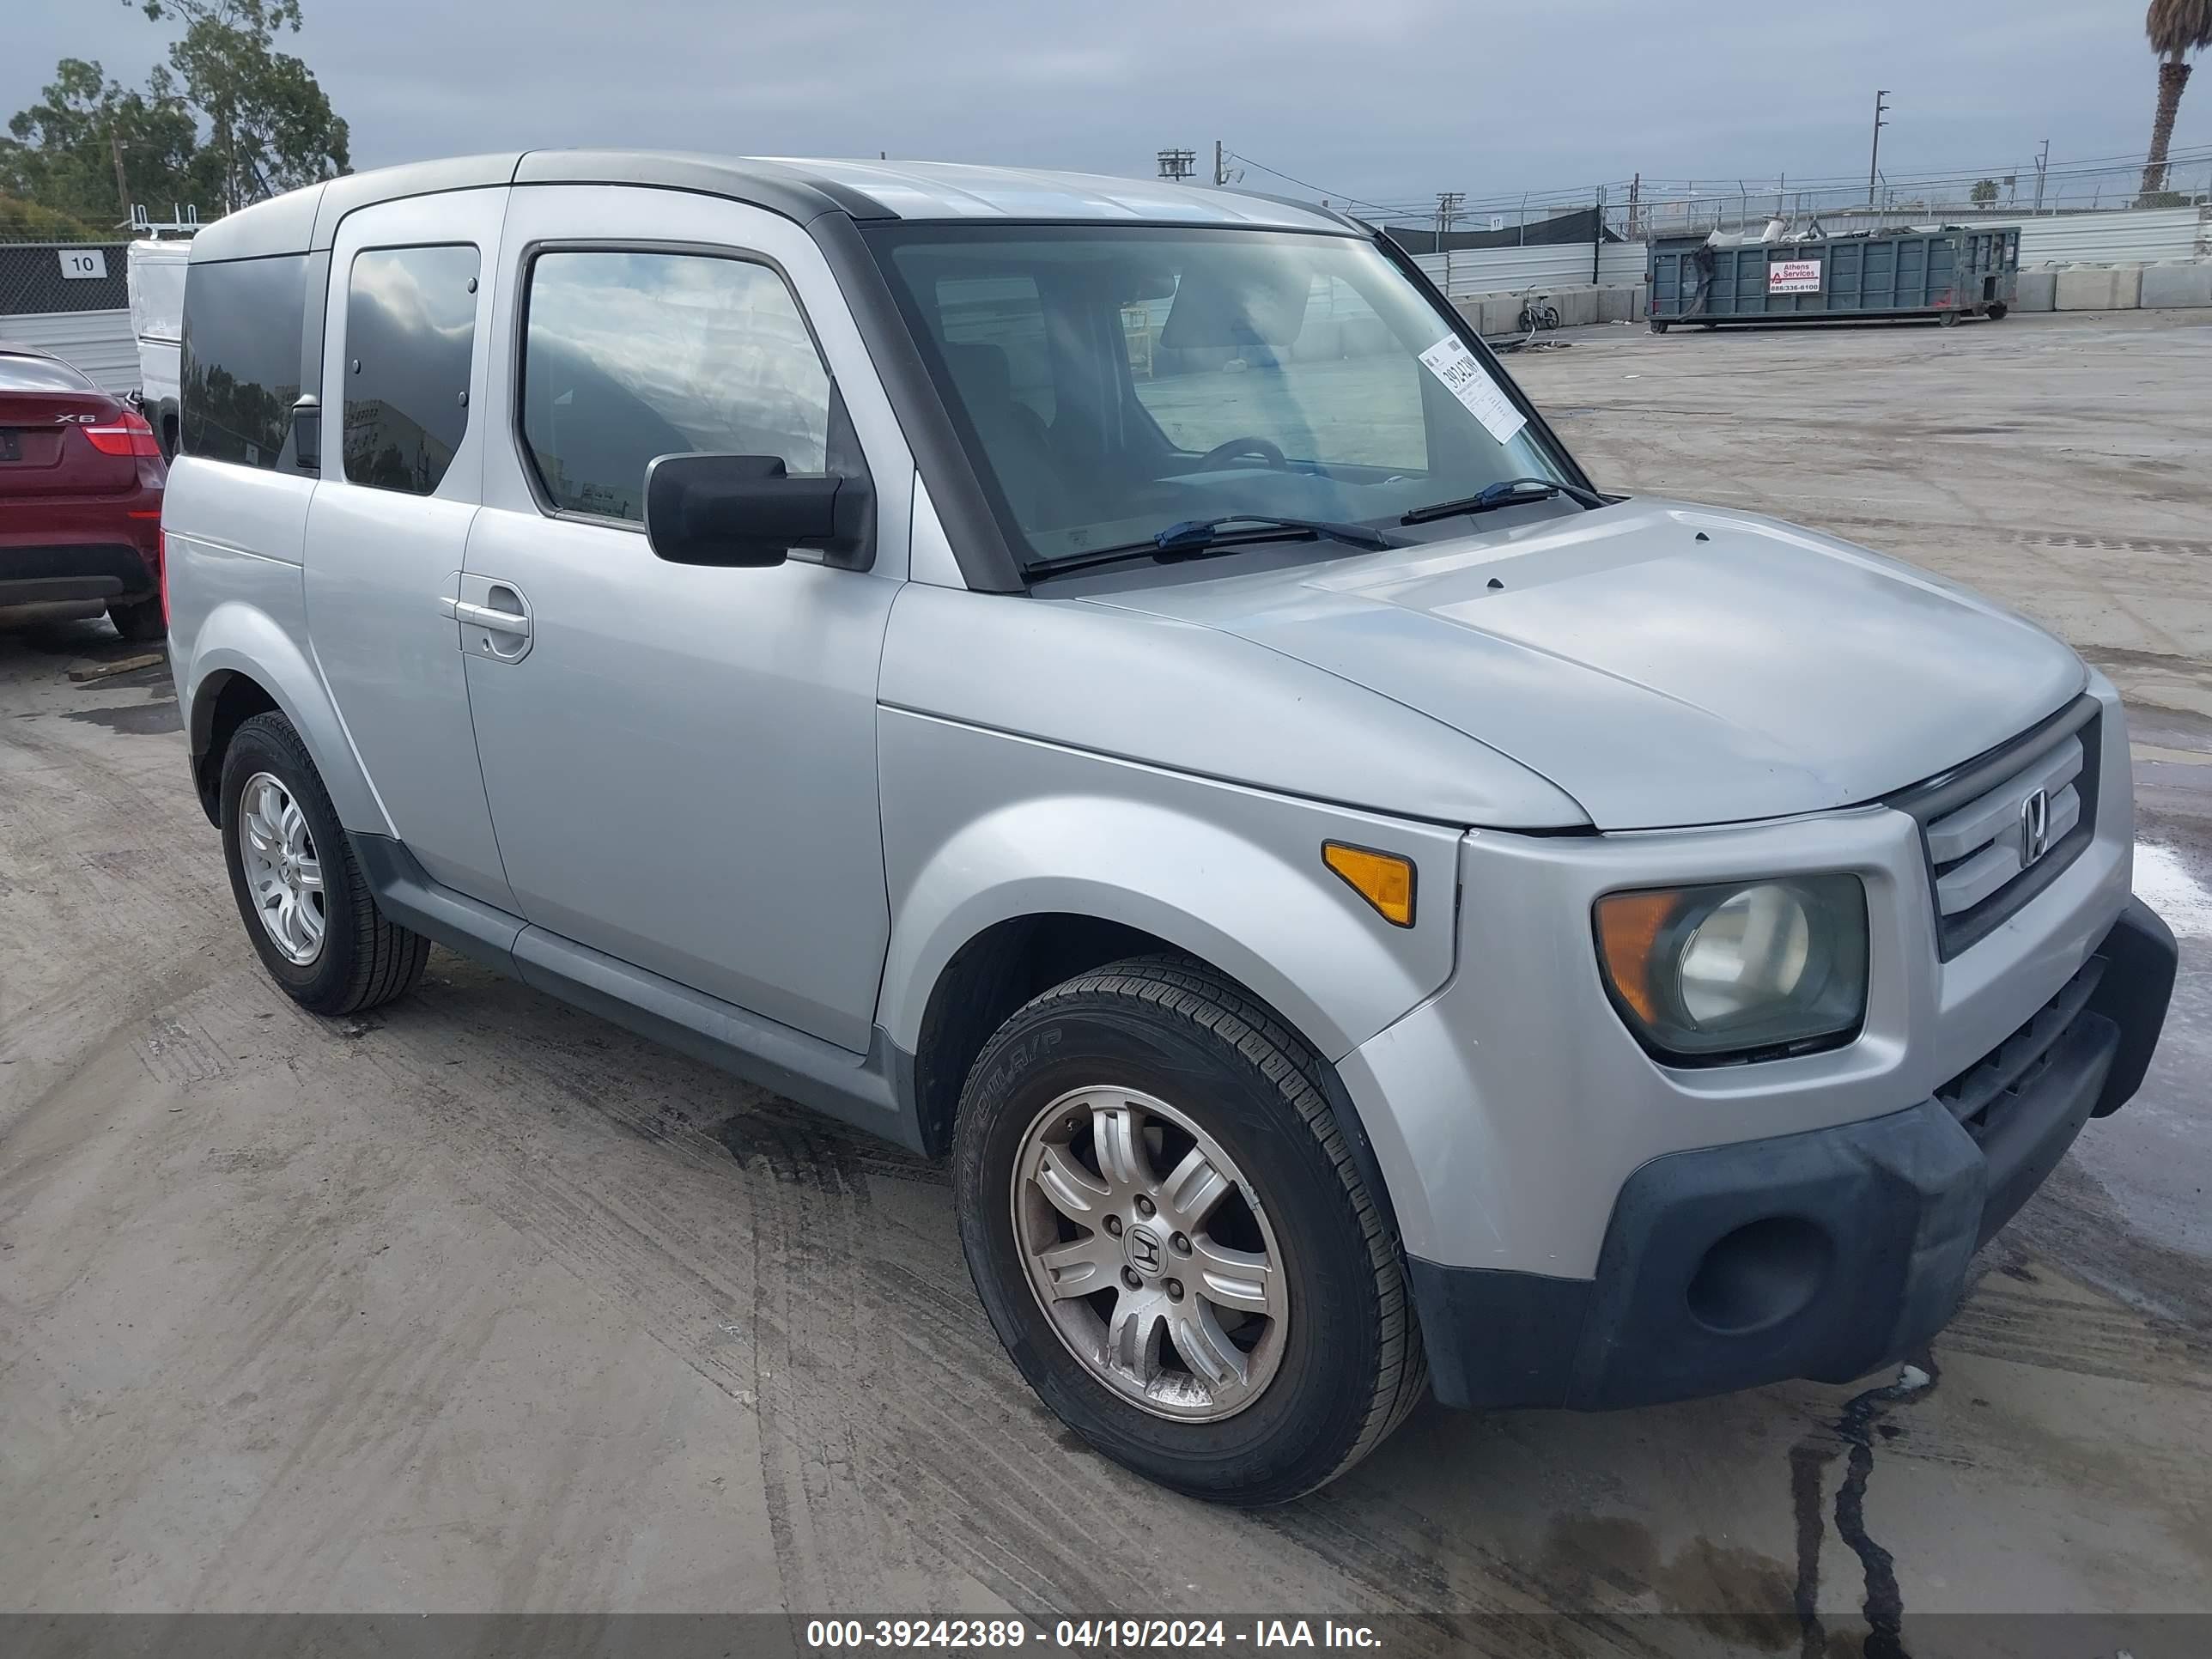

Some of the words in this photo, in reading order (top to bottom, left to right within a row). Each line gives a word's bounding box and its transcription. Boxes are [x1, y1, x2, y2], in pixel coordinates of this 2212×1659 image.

[71, 257, 94, 272] 10
[1443, 355, 1480, 389] 39242389
[54, 414, 96, 423] X6
